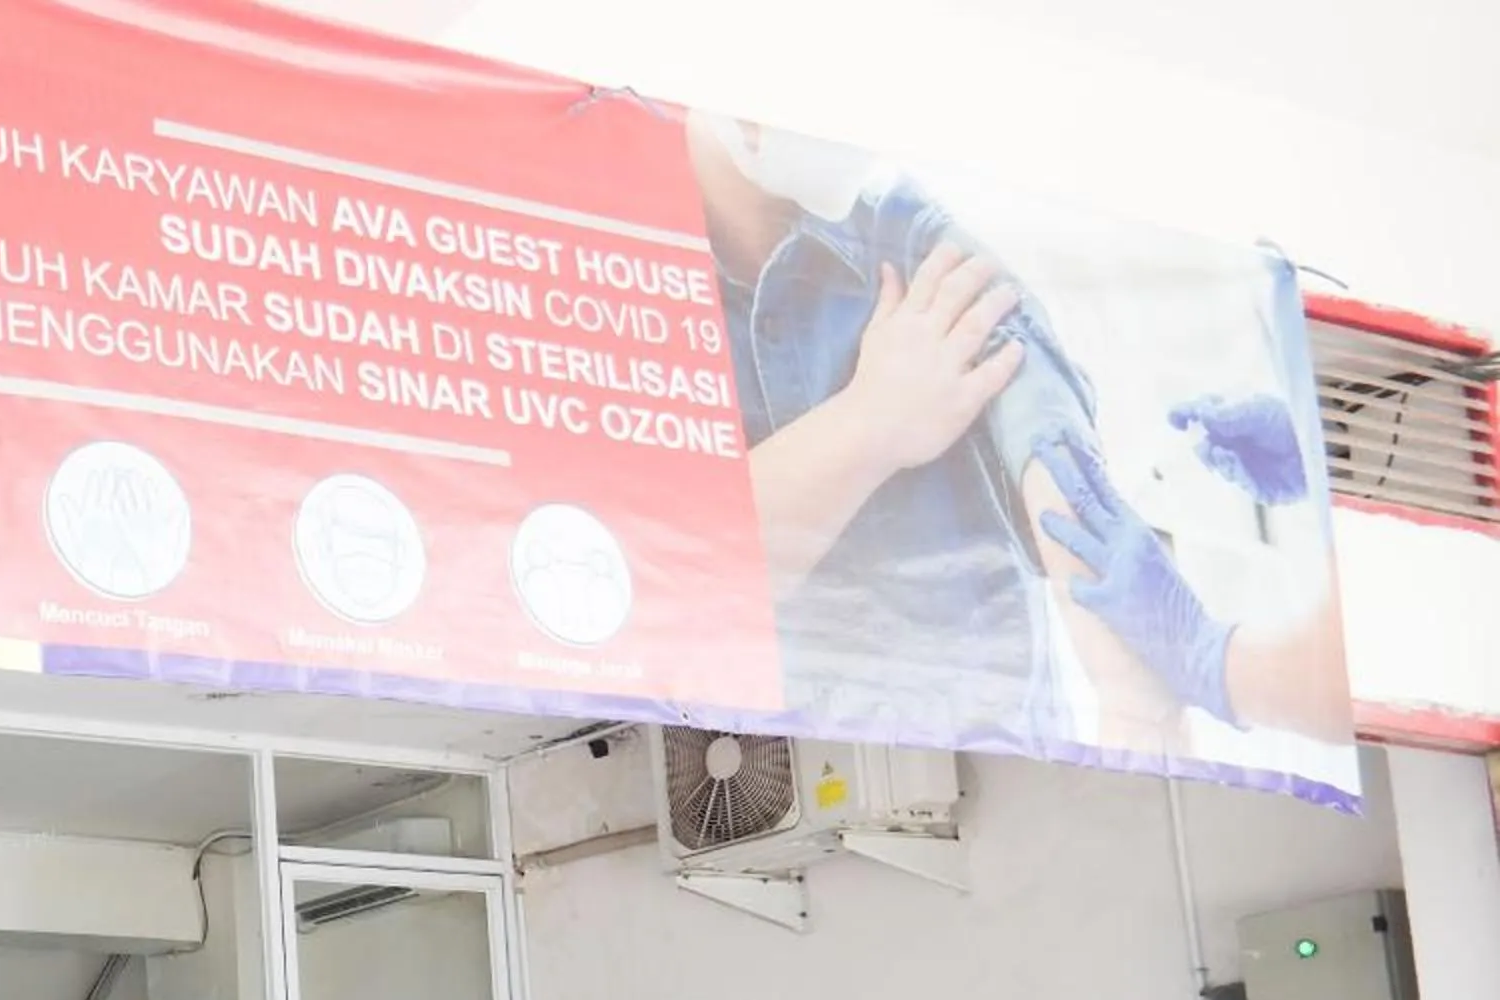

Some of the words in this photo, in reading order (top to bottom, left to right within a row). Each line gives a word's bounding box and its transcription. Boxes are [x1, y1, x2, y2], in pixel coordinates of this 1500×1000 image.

[59, 139, 318, 227] KARYAWAN
[333, 197, 417, 247] AVA
[425, 215, 564, 277] GUEST
[577, 247, 713, 306] HOUSE
[160, 213, 321, 281] SUDAH
[336, 247, 533, 321] DIVAKSIN
[544, 288, 669, 346] COVID
[681, 315, 722, 354] 19
[82, 257, 250, 326] KAMAR
[263, 291, 421, 356] SUDAH
[433, 321, 475, 364] DI
[485, 337, 731, 408] STERILISASI
[357, 360, 493, 420] SINAR
[503, 386, 589, 434] UVC
[600, 402, 741, 459] OZONE
